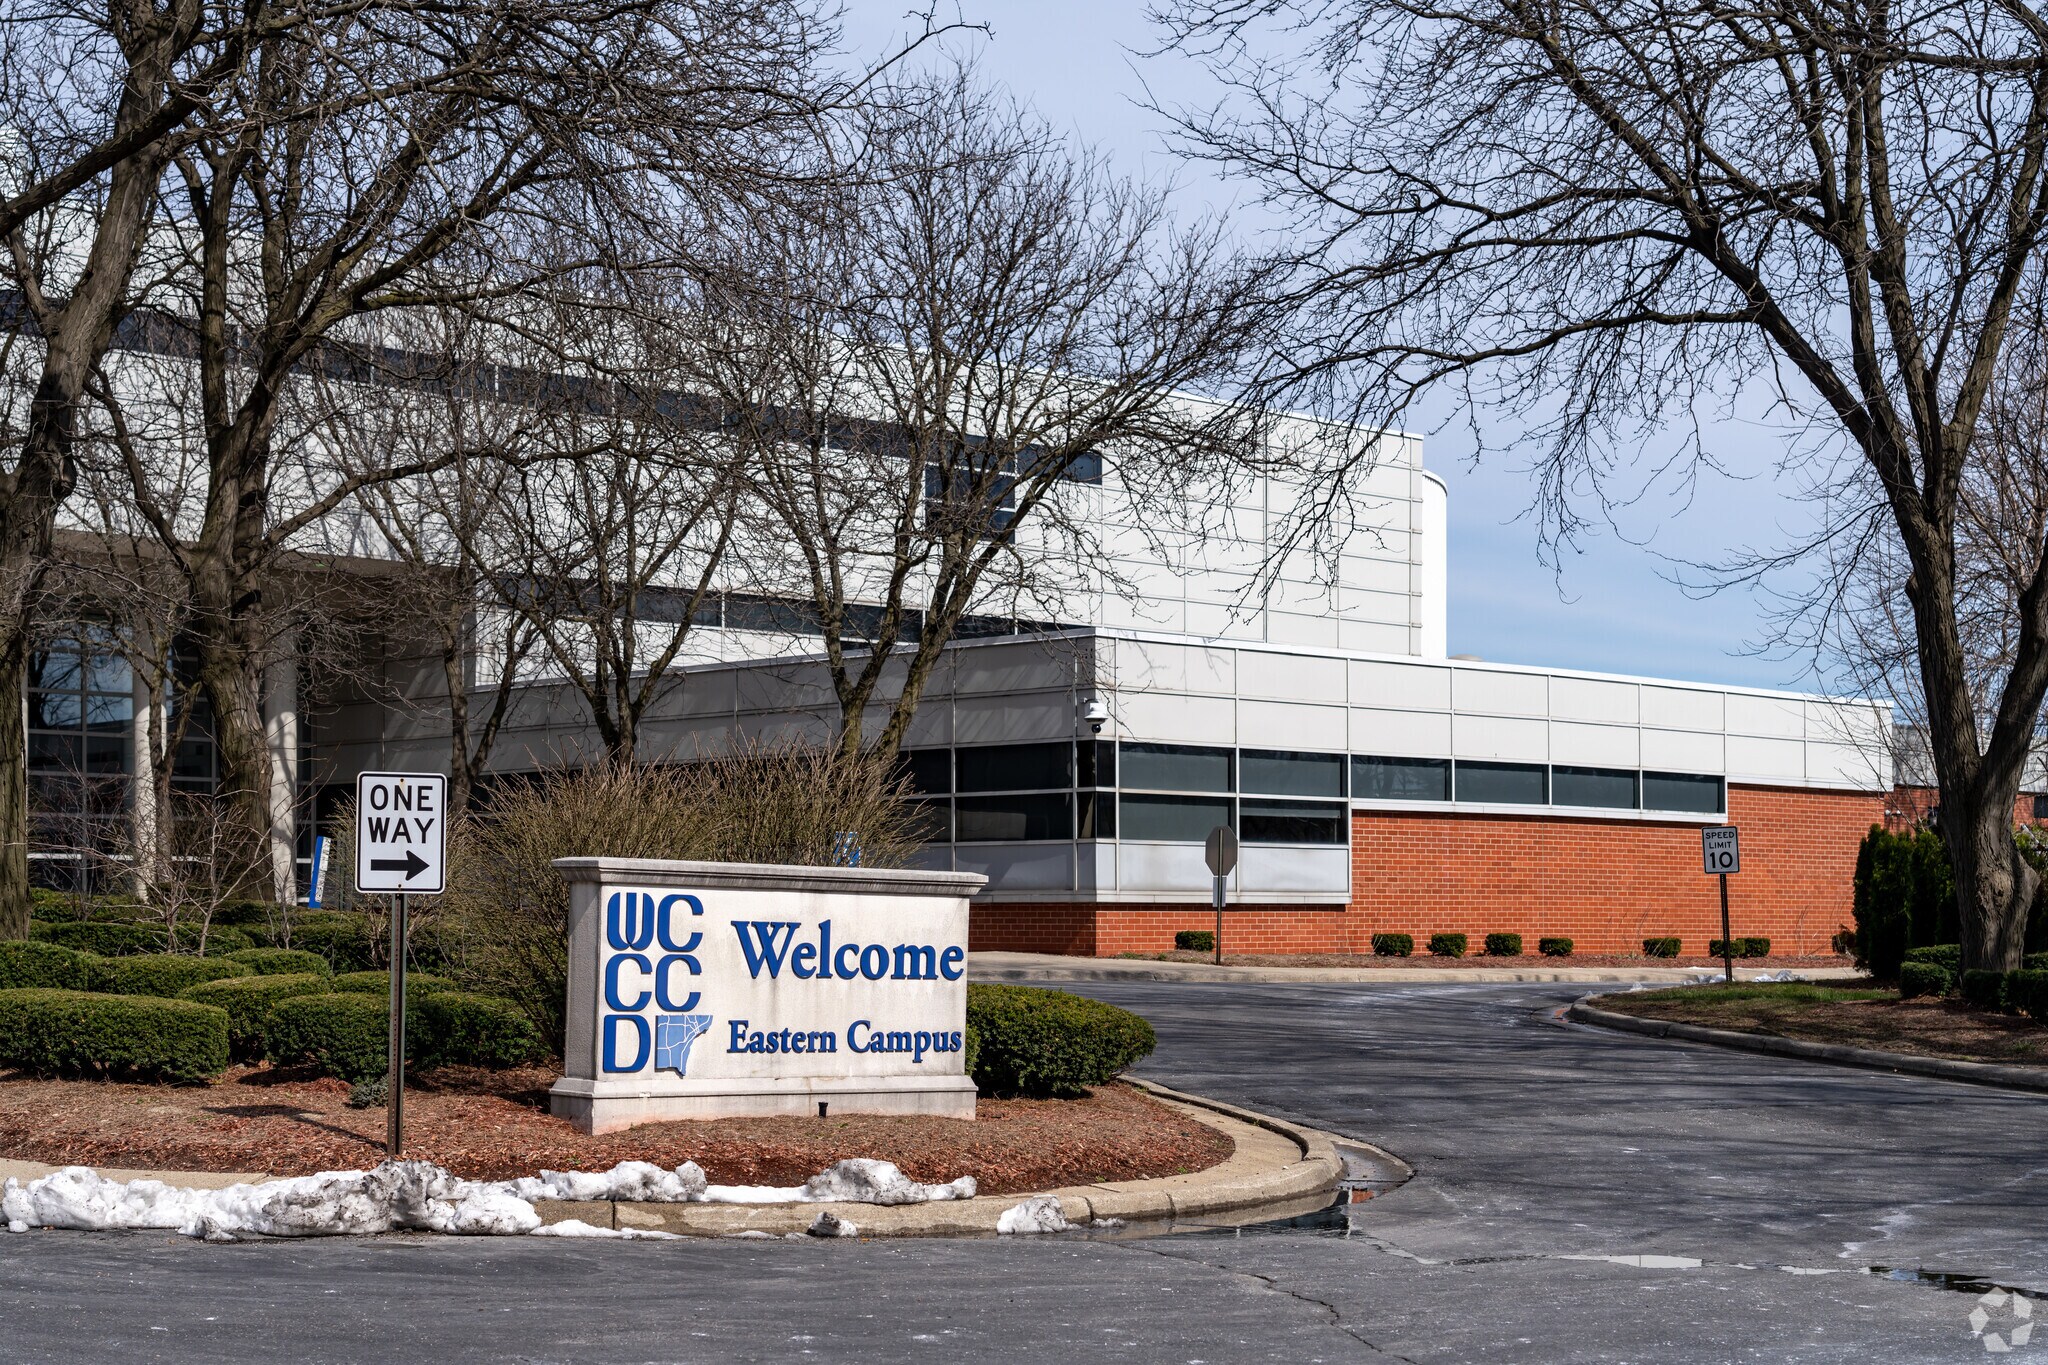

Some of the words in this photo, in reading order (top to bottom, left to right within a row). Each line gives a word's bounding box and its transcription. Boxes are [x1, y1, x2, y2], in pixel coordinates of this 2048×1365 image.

[370, 784, 434, 812] ONE
[368, 817, 435, 844] WAY
[1705, 831, 1735, 839] SPEED
[1708, 841, 1732, 849] LIMIT
[1709, 851, 1733, 869] 10
[730, 919, 965, 981] Welcome
[605, 953, 702, 1012] CC
[602, 1014, 651, 1074] D
[726, 1019, 838, 1054] Eastern
[847, 1019, 963, 1064] Campus
